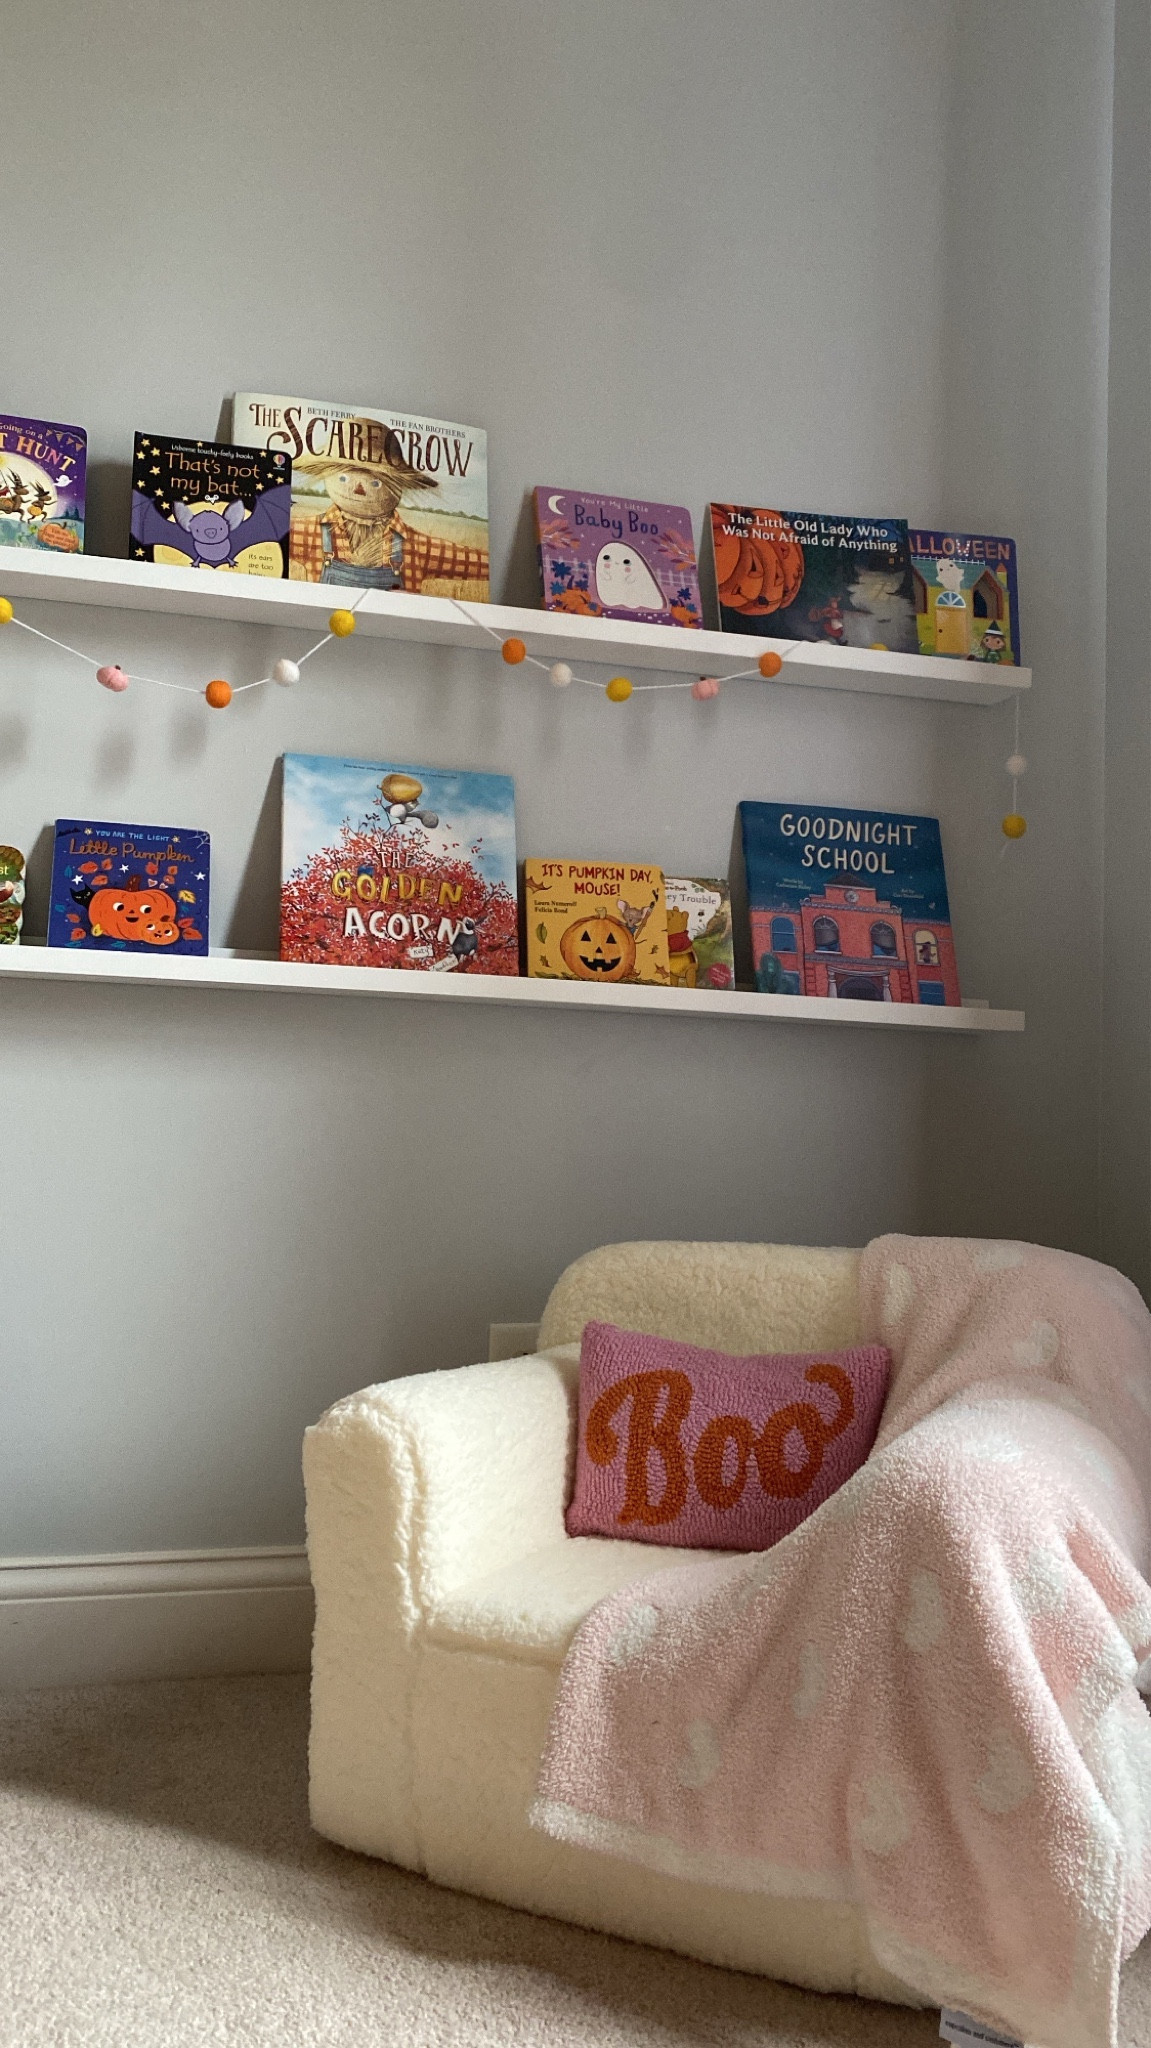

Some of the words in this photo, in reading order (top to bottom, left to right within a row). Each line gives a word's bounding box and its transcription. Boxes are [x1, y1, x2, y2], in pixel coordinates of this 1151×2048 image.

[307, 407, 329, 416] BETH
[331, 410, 356, 420] FERRY
[25, 429, 36, 437] on
[249, 403, 281, 428] THE
[267, 406, 474, 477] SCARECROW
[390, 418, 406, 428] THE
[408, 422, 425, 431] FAN
[425, 425, 466, 439] BROTHERS
[16, 435, 76, 472] HUNT
[165, 451, 221, 475] That's
[227, 464, 261, 479] not
[170, 477, 200, 496] my
[208, 475, 252, 497] bat...
[581, 498, 606, 506] You're
[609, 501, 622, 510] My
[624, 503, 649, 513] Little
[574, 504, 623, 539] Baby
[628, 510, 659, 535] Boo
[728, 512, 753, 525] The
[756, 516, 791, 530] Little
[793, 519, 818, 533] Old
[821, 522, 853, 538] Lady
[857, 525, 888, 538] Who
[722, 524, 749, 538] Was
[752, 528, 777, 542] Not
[778, 531, 819, 546] Afraid
[821, 537, 836, 547] of
[838, 537, 898, 553] Anything
[96, 829, 111, 837] YOU
[112, 830, 126, 839] ARE
[128, 832, 144, 840] THE
[147, 834, 170, 842] LIGHT
[780, 813, 918, 846] GOODNIGHT
[69, 838, 118, 856] Little
[121, 841, 195, 866] Pumpkin
[378, 851, 415, 868] THE
[801, 844, 895, 875] SCHOOL
[542, 863, 563, 877] IT'S
[568, 865, 625, 881] PUMPKIN
[630, 869, 653, 883] DAY,
[331, 870, 463, 905] GOLDEN
[574, 881, 621, 897] MOUSE!
[680, 893, 717, 905] Trouble
[344, 907, 467, 944] ACORN
[586, 1363, 855, 1527] Boo
